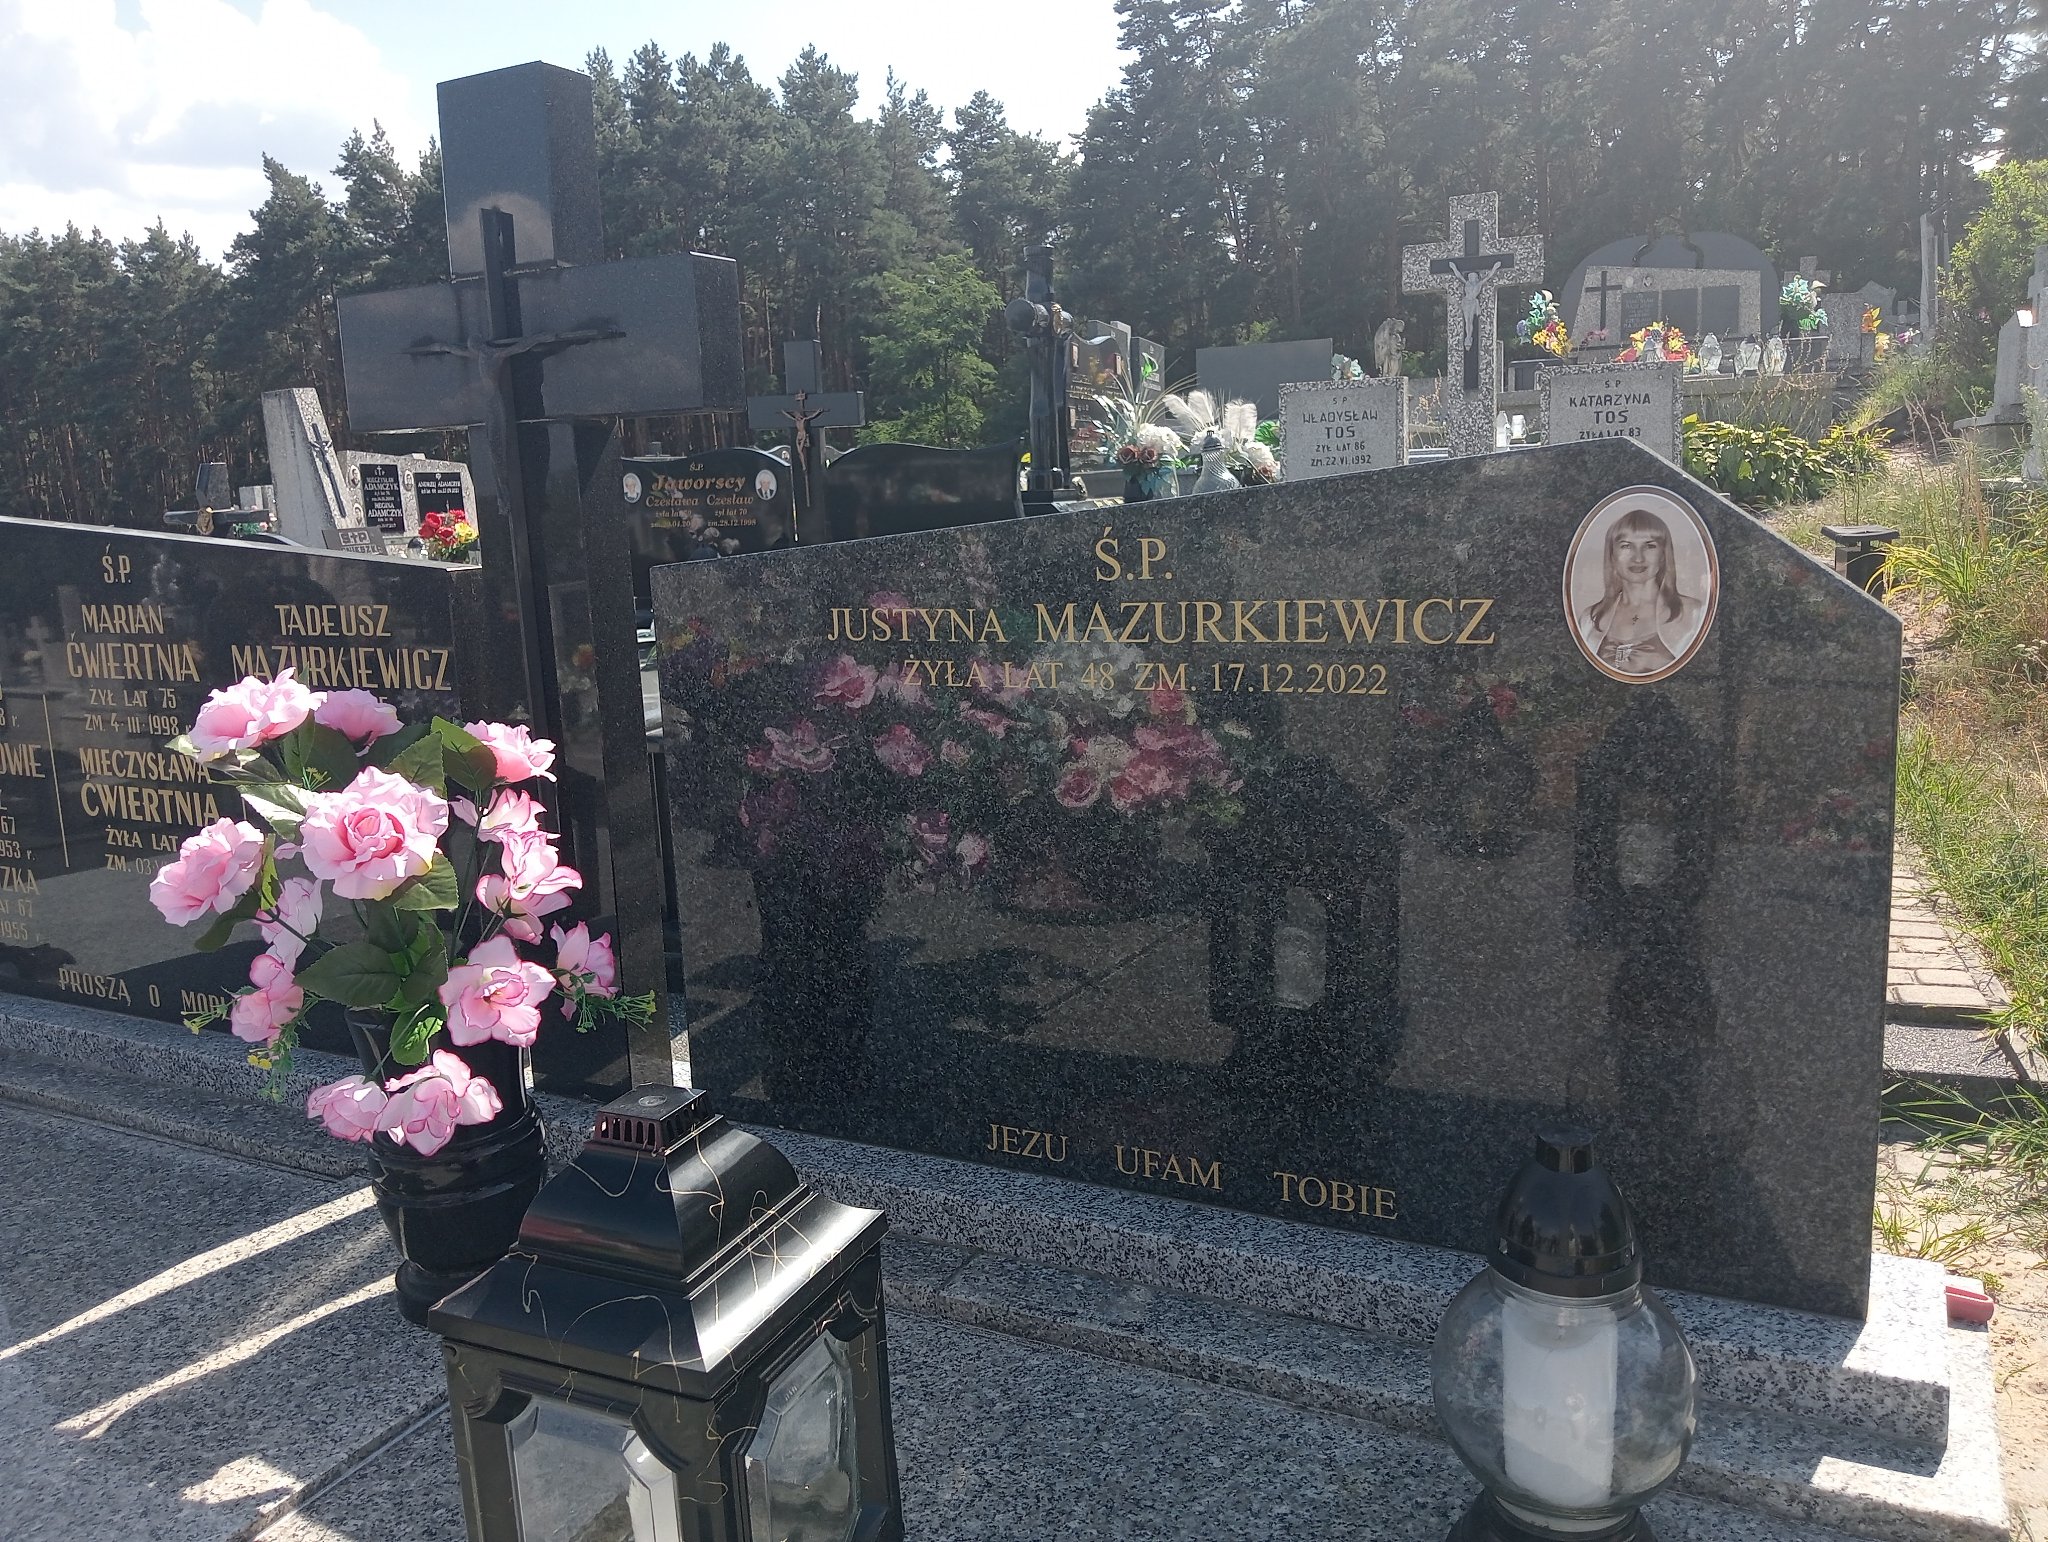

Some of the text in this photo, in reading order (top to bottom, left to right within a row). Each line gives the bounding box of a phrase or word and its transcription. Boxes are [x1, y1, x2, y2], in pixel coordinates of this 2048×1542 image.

[1569, 393, 1651, 407] KATARZYNA
[1302, 408, 1378, 424] WŁADYSŁAW
[1336, 442, 1352, 452] LAT
[1354, 441, 1366, 451] 86
[1606, 429, 1625, 438] LAT
[1628, 426, 1641, 437] 83
[651, 474, 747, 492] Jaworscy
[1094, 527, 1174, 582] Ś.P.
[81, 604, 165, 635] MARIAN
[274, 604, 392, 637] TADEUSZ
[826, 598, 1496, 646] JUSTYNA MAZURKIEWICZ
[66, 631, 201, 683] ĆWIERTNIA
[231, 644, 452, 691] MAZURKIEWICZ
[903, 653, 1389, 695] ŻYŁA LAT 48 ZM. 17.12.2022
[89, 684, 177, 709] ŻYŁ LAT 75
[84, 713, 106, 732] ZM.
[79, 747, 211, 785] MIECZYSŁAWA
[80, 774, 221, 827] ĆWIERTNIA
[105, 824, 179, 852] ŻYŁA LAT
[104, 853, 132, 873] ZM.
[18, 899, 33, 918] 67
[58, 967, 132, 1006] PROSZĄ
[149, 984, 161, 1008] O
[986, 1123, 1399, 1221] JEZU UFAM TOBIE
